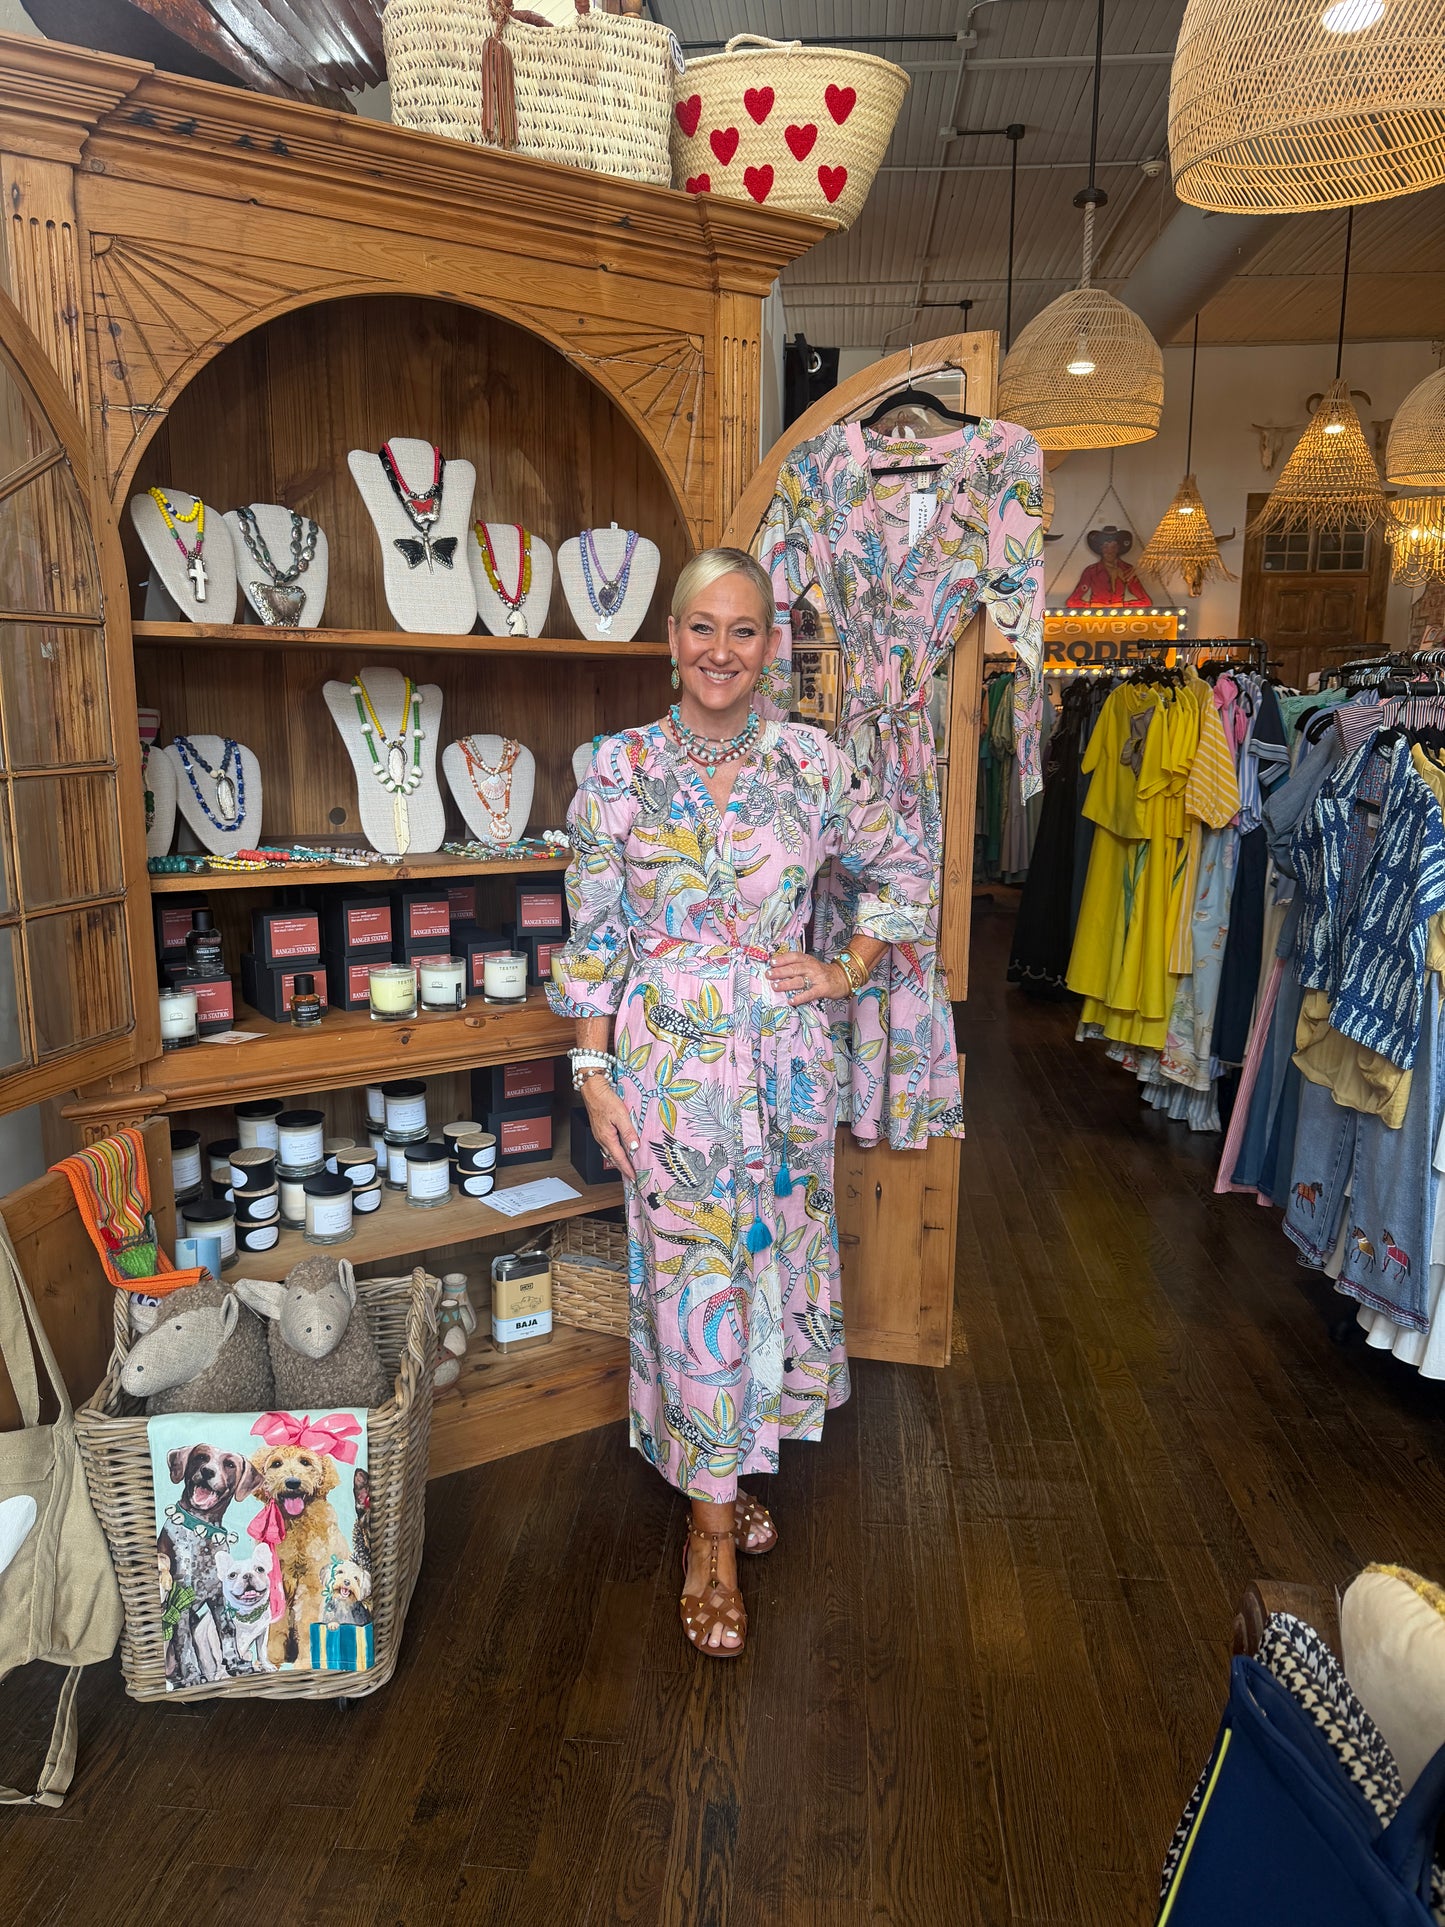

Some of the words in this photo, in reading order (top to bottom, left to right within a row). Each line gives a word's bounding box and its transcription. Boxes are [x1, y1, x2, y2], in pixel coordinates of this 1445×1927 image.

[1045, 622, 1171, 635] COWBOY
[1044, 640, 1168, 663] RODE
[351, 936, 371, 944] RANGER
[370, 934, 389, 942] STATION
[275, 947, 296, 955] RANGER
[295, 945, 317, 953] STATION
[207, 1010, 230, 1019] STATION
[503, 1145, 522, 1153] RANGER
[521, 1143, 539, 1151] STATION
[516, 1319, 538, 1329] BAJA
